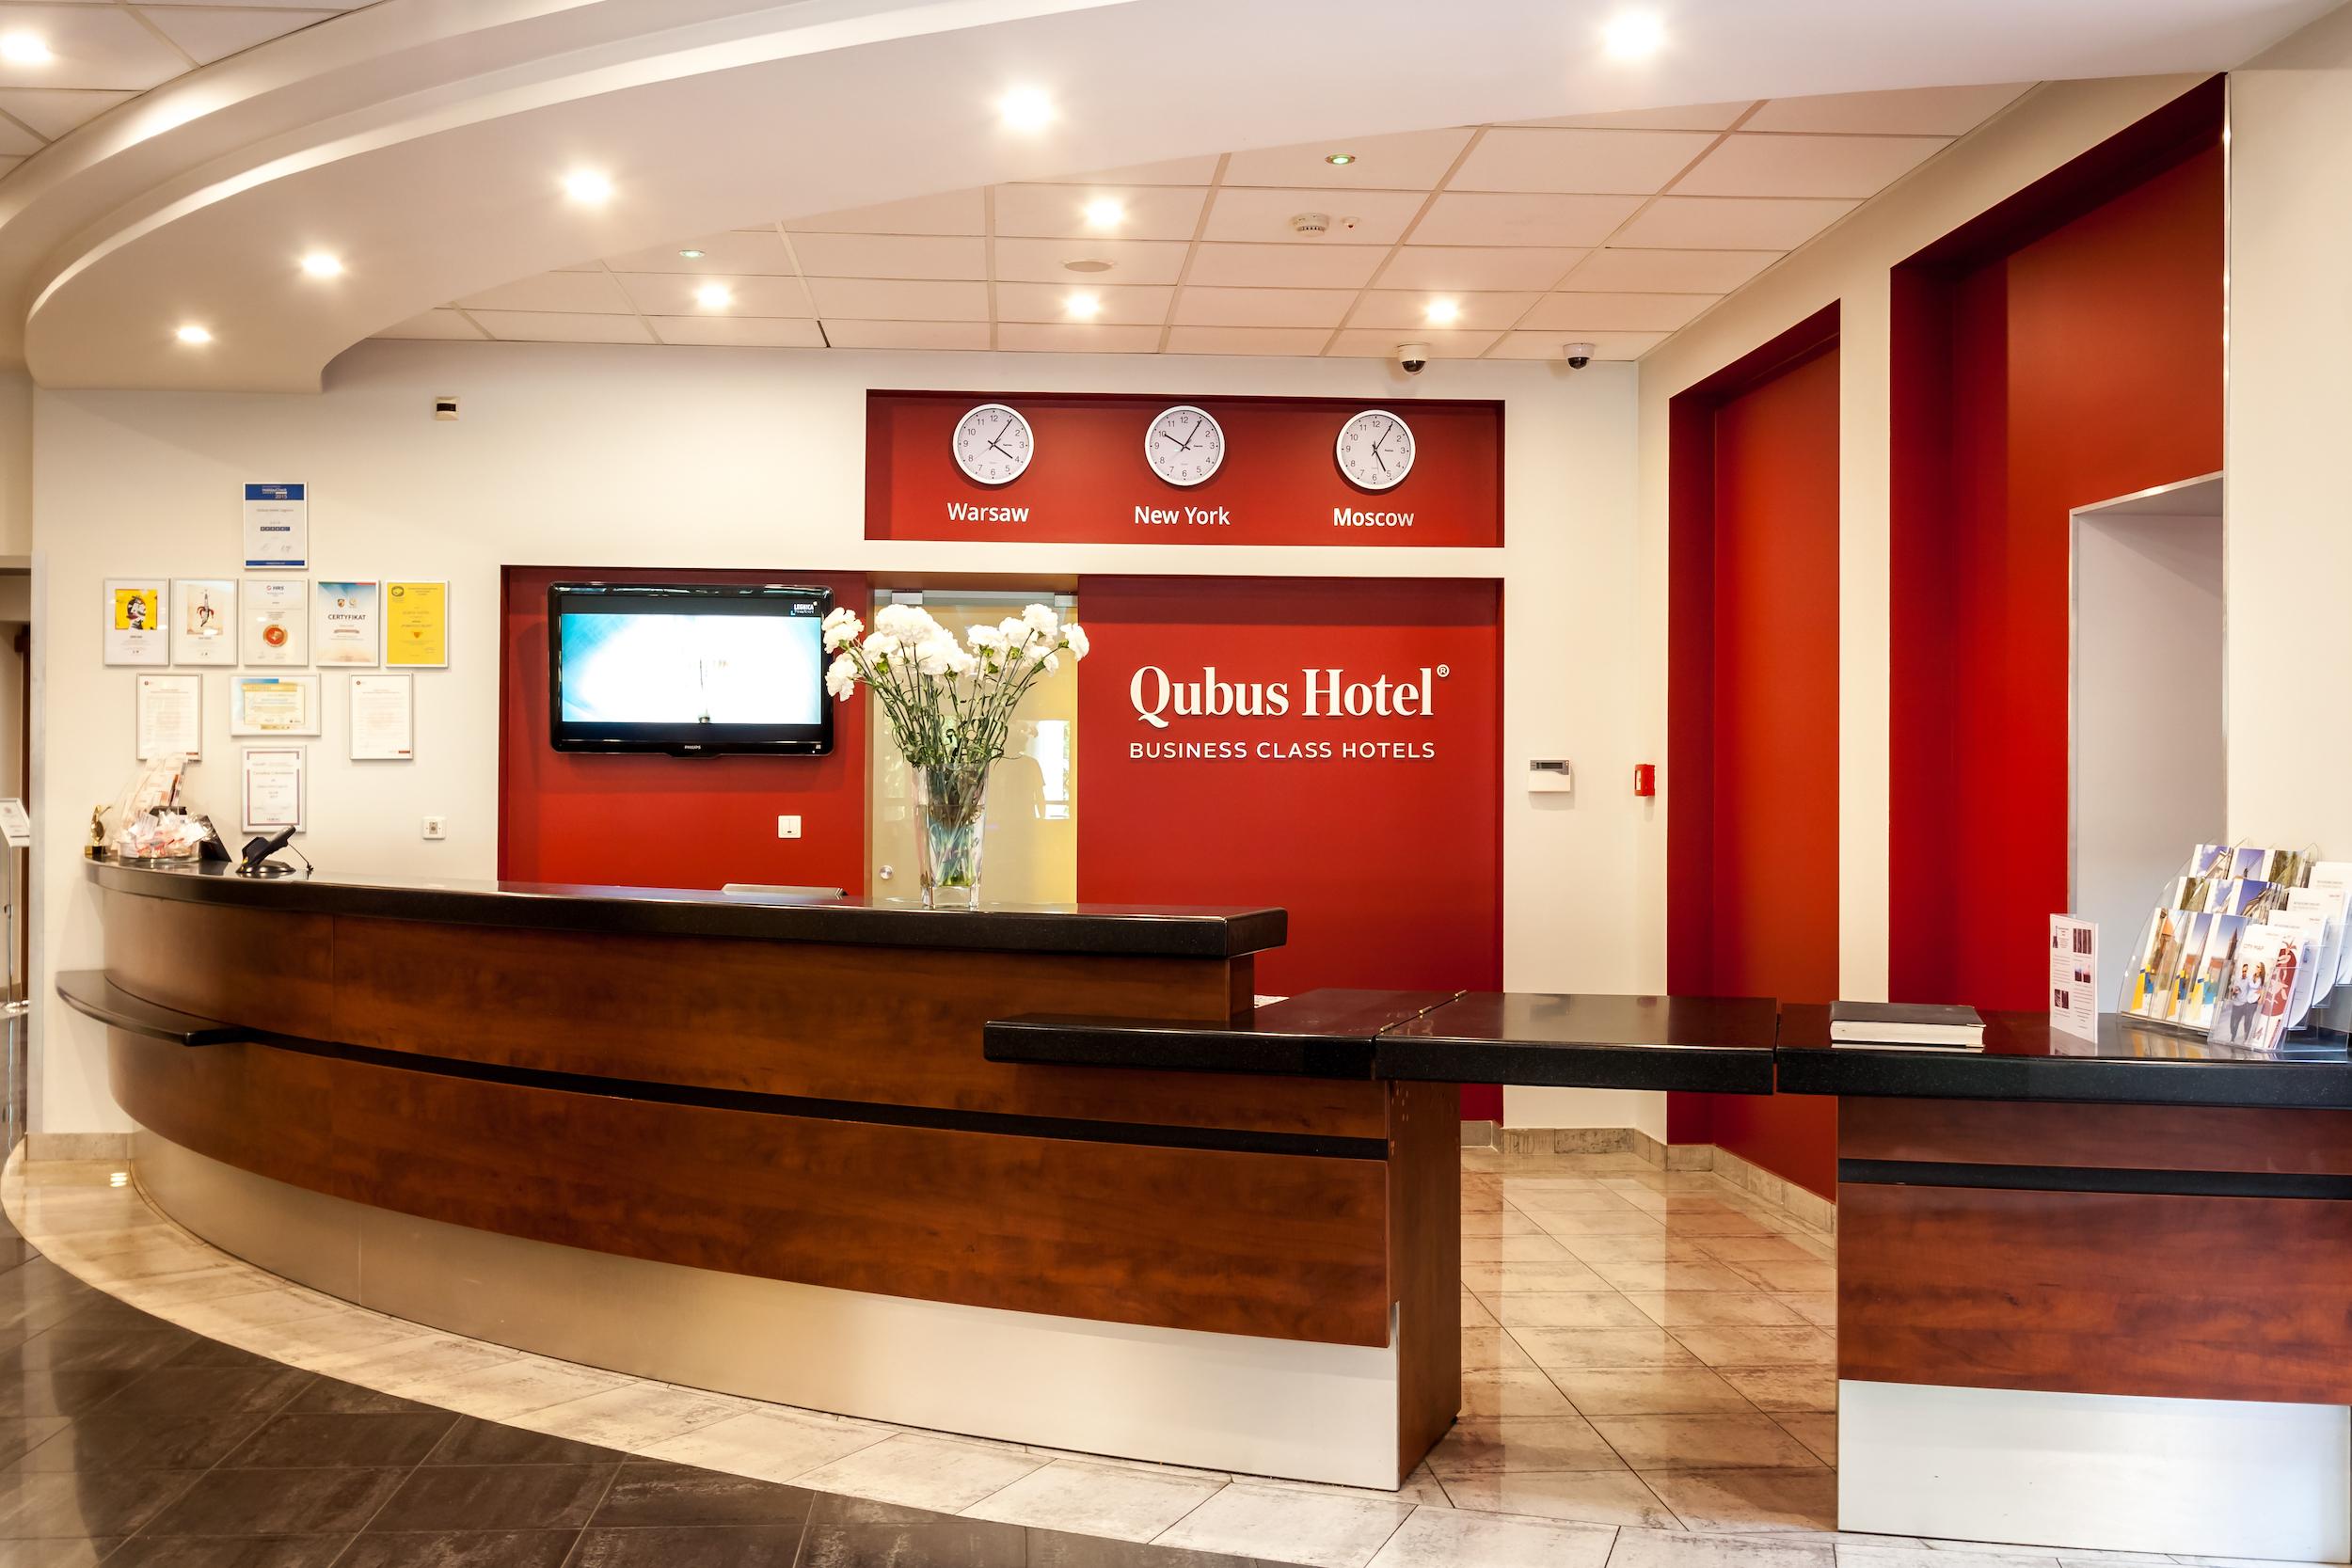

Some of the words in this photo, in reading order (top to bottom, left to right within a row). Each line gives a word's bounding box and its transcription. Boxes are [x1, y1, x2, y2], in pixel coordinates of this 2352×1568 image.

[946, 502, 1029, 522] Warsaw
[1134, 505, 1180, 525] New
[1184, 505, 1231, 526] York
[1333, 507, 1415, 527] Moscow
[1130, 665, 1290, 728] Qubus
[1129, 741, 1248, 759] BUSINESS
[1256, 741, 1333, 759] CLASS
[1342, 741, 1436, 759] HOTELS
